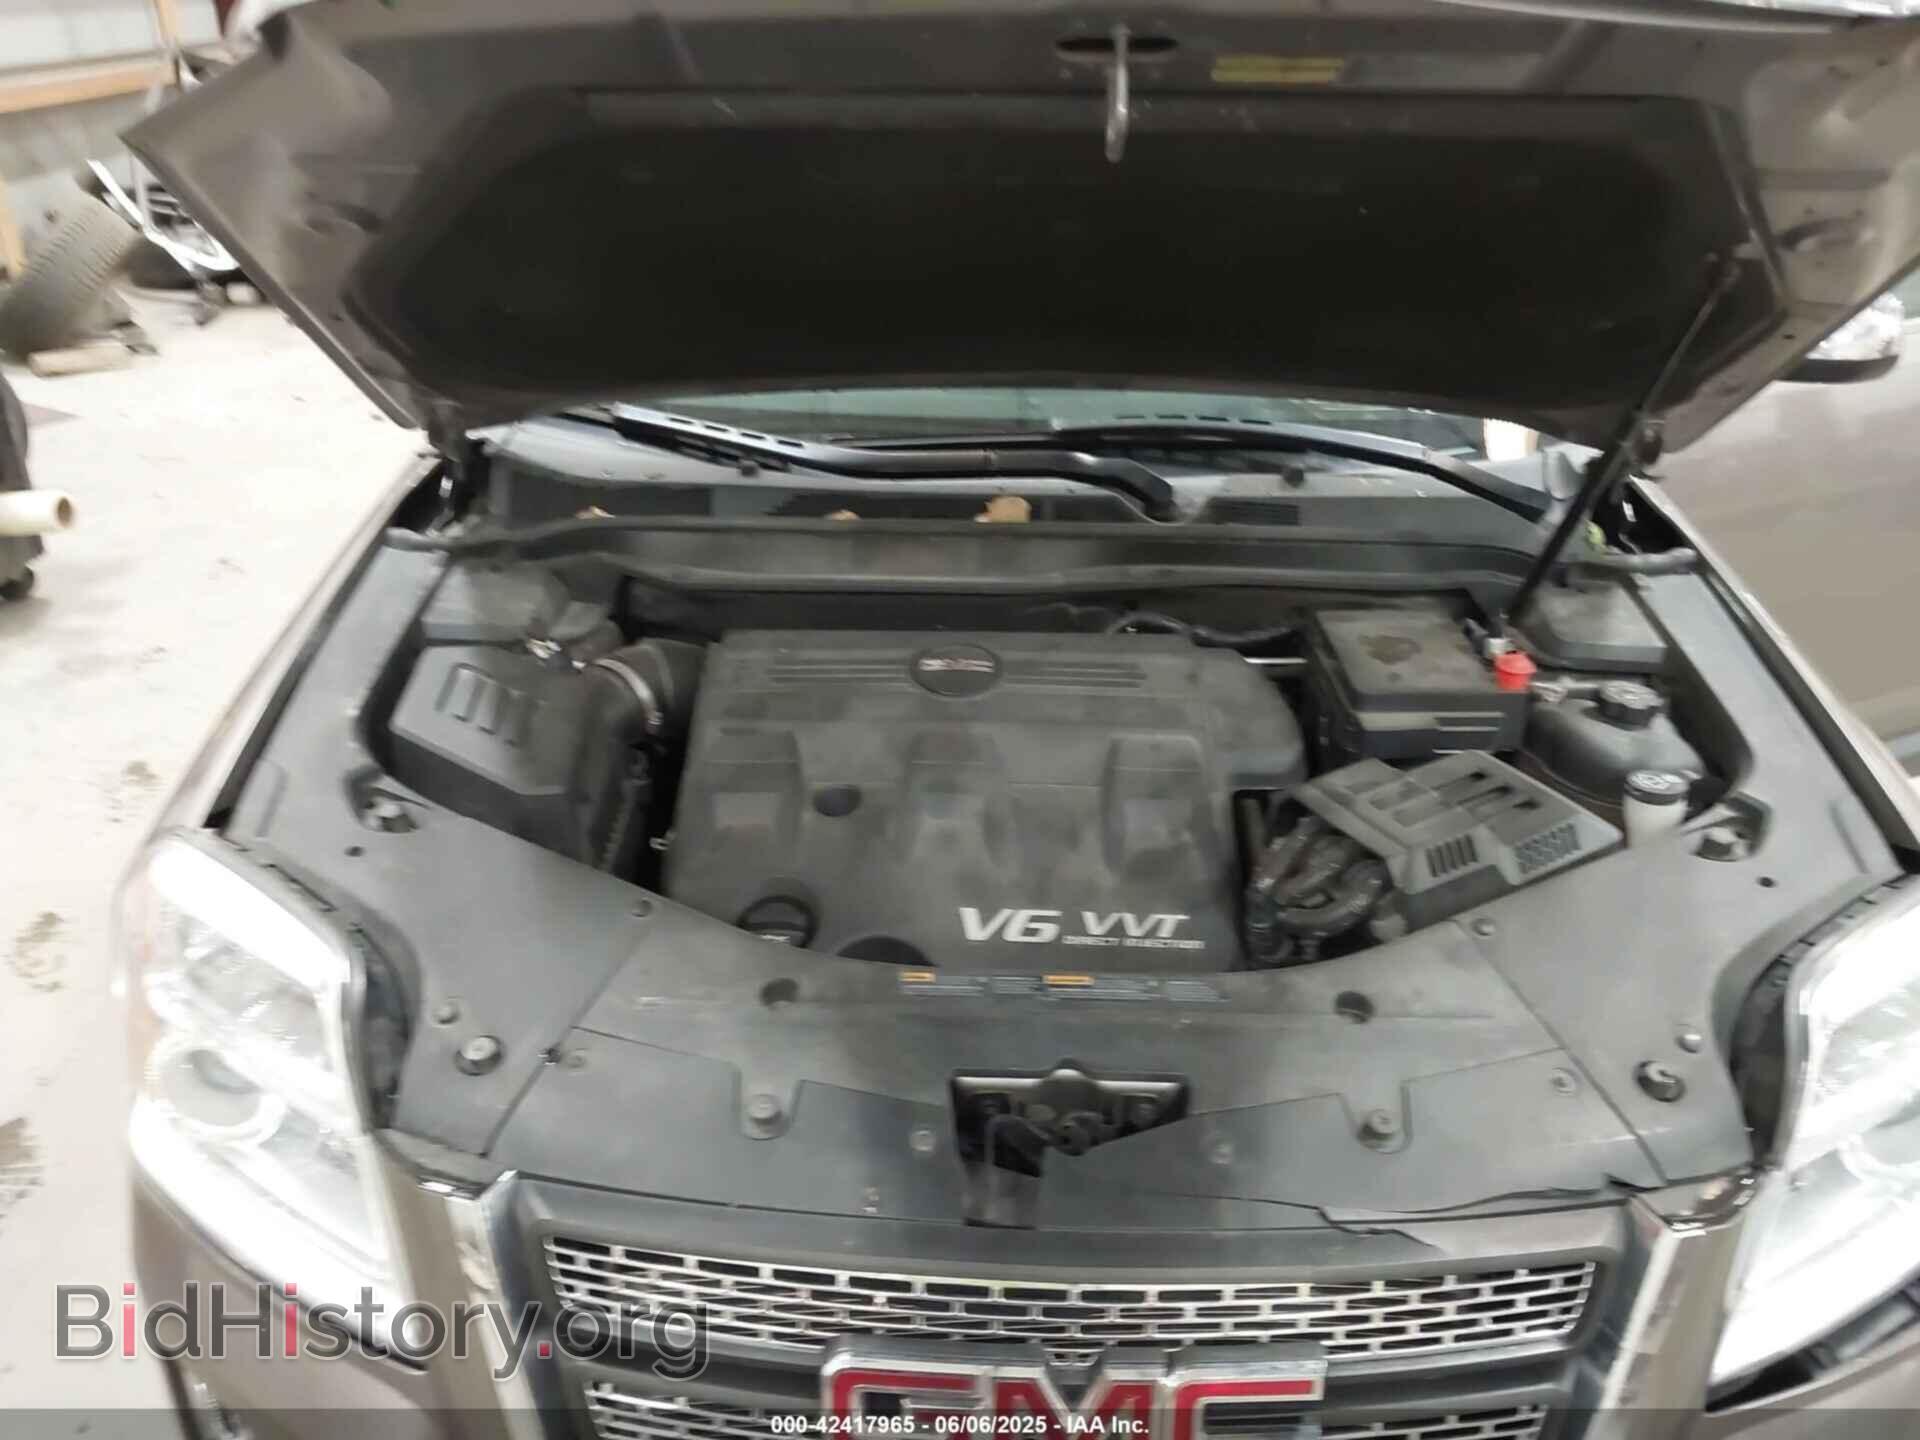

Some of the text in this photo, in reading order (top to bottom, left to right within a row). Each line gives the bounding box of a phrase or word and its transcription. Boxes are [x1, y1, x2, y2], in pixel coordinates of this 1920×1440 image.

[959, 907, 1191, 943] V6 VVT
[822, 1350, 1328, 1440] GMC
